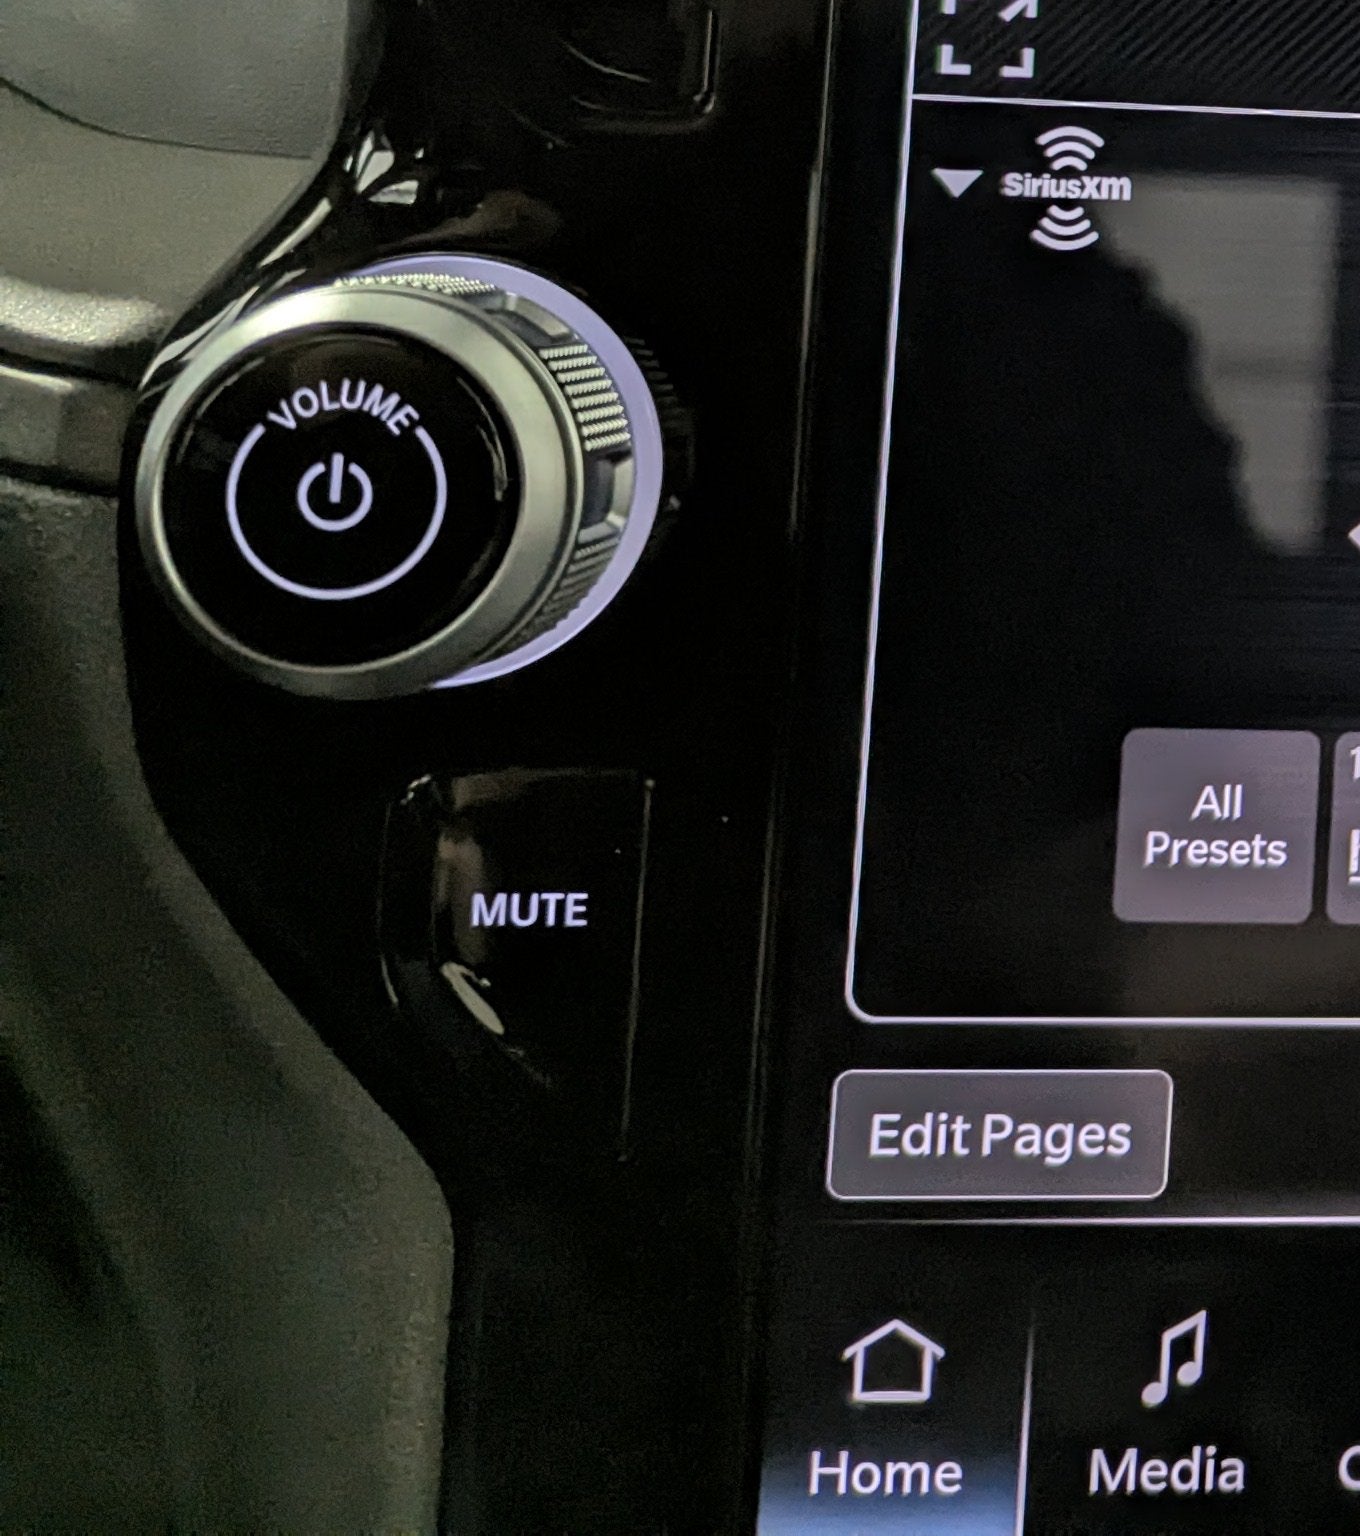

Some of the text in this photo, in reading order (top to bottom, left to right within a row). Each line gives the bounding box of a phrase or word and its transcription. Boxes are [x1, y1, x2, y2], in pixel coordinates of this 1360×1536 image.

[268, 378, 420, 436] VOLUME
[1191, 784, 1243, 820] All
[1145, 830, 1287, 866] Presets
[471, 892, 589, 927] MUTE
[869, 1112, 1132, 1166] Edit Pages
[809, 1450, 963, 1496] Home
[1089, 1445, 1245, 1494] Media
